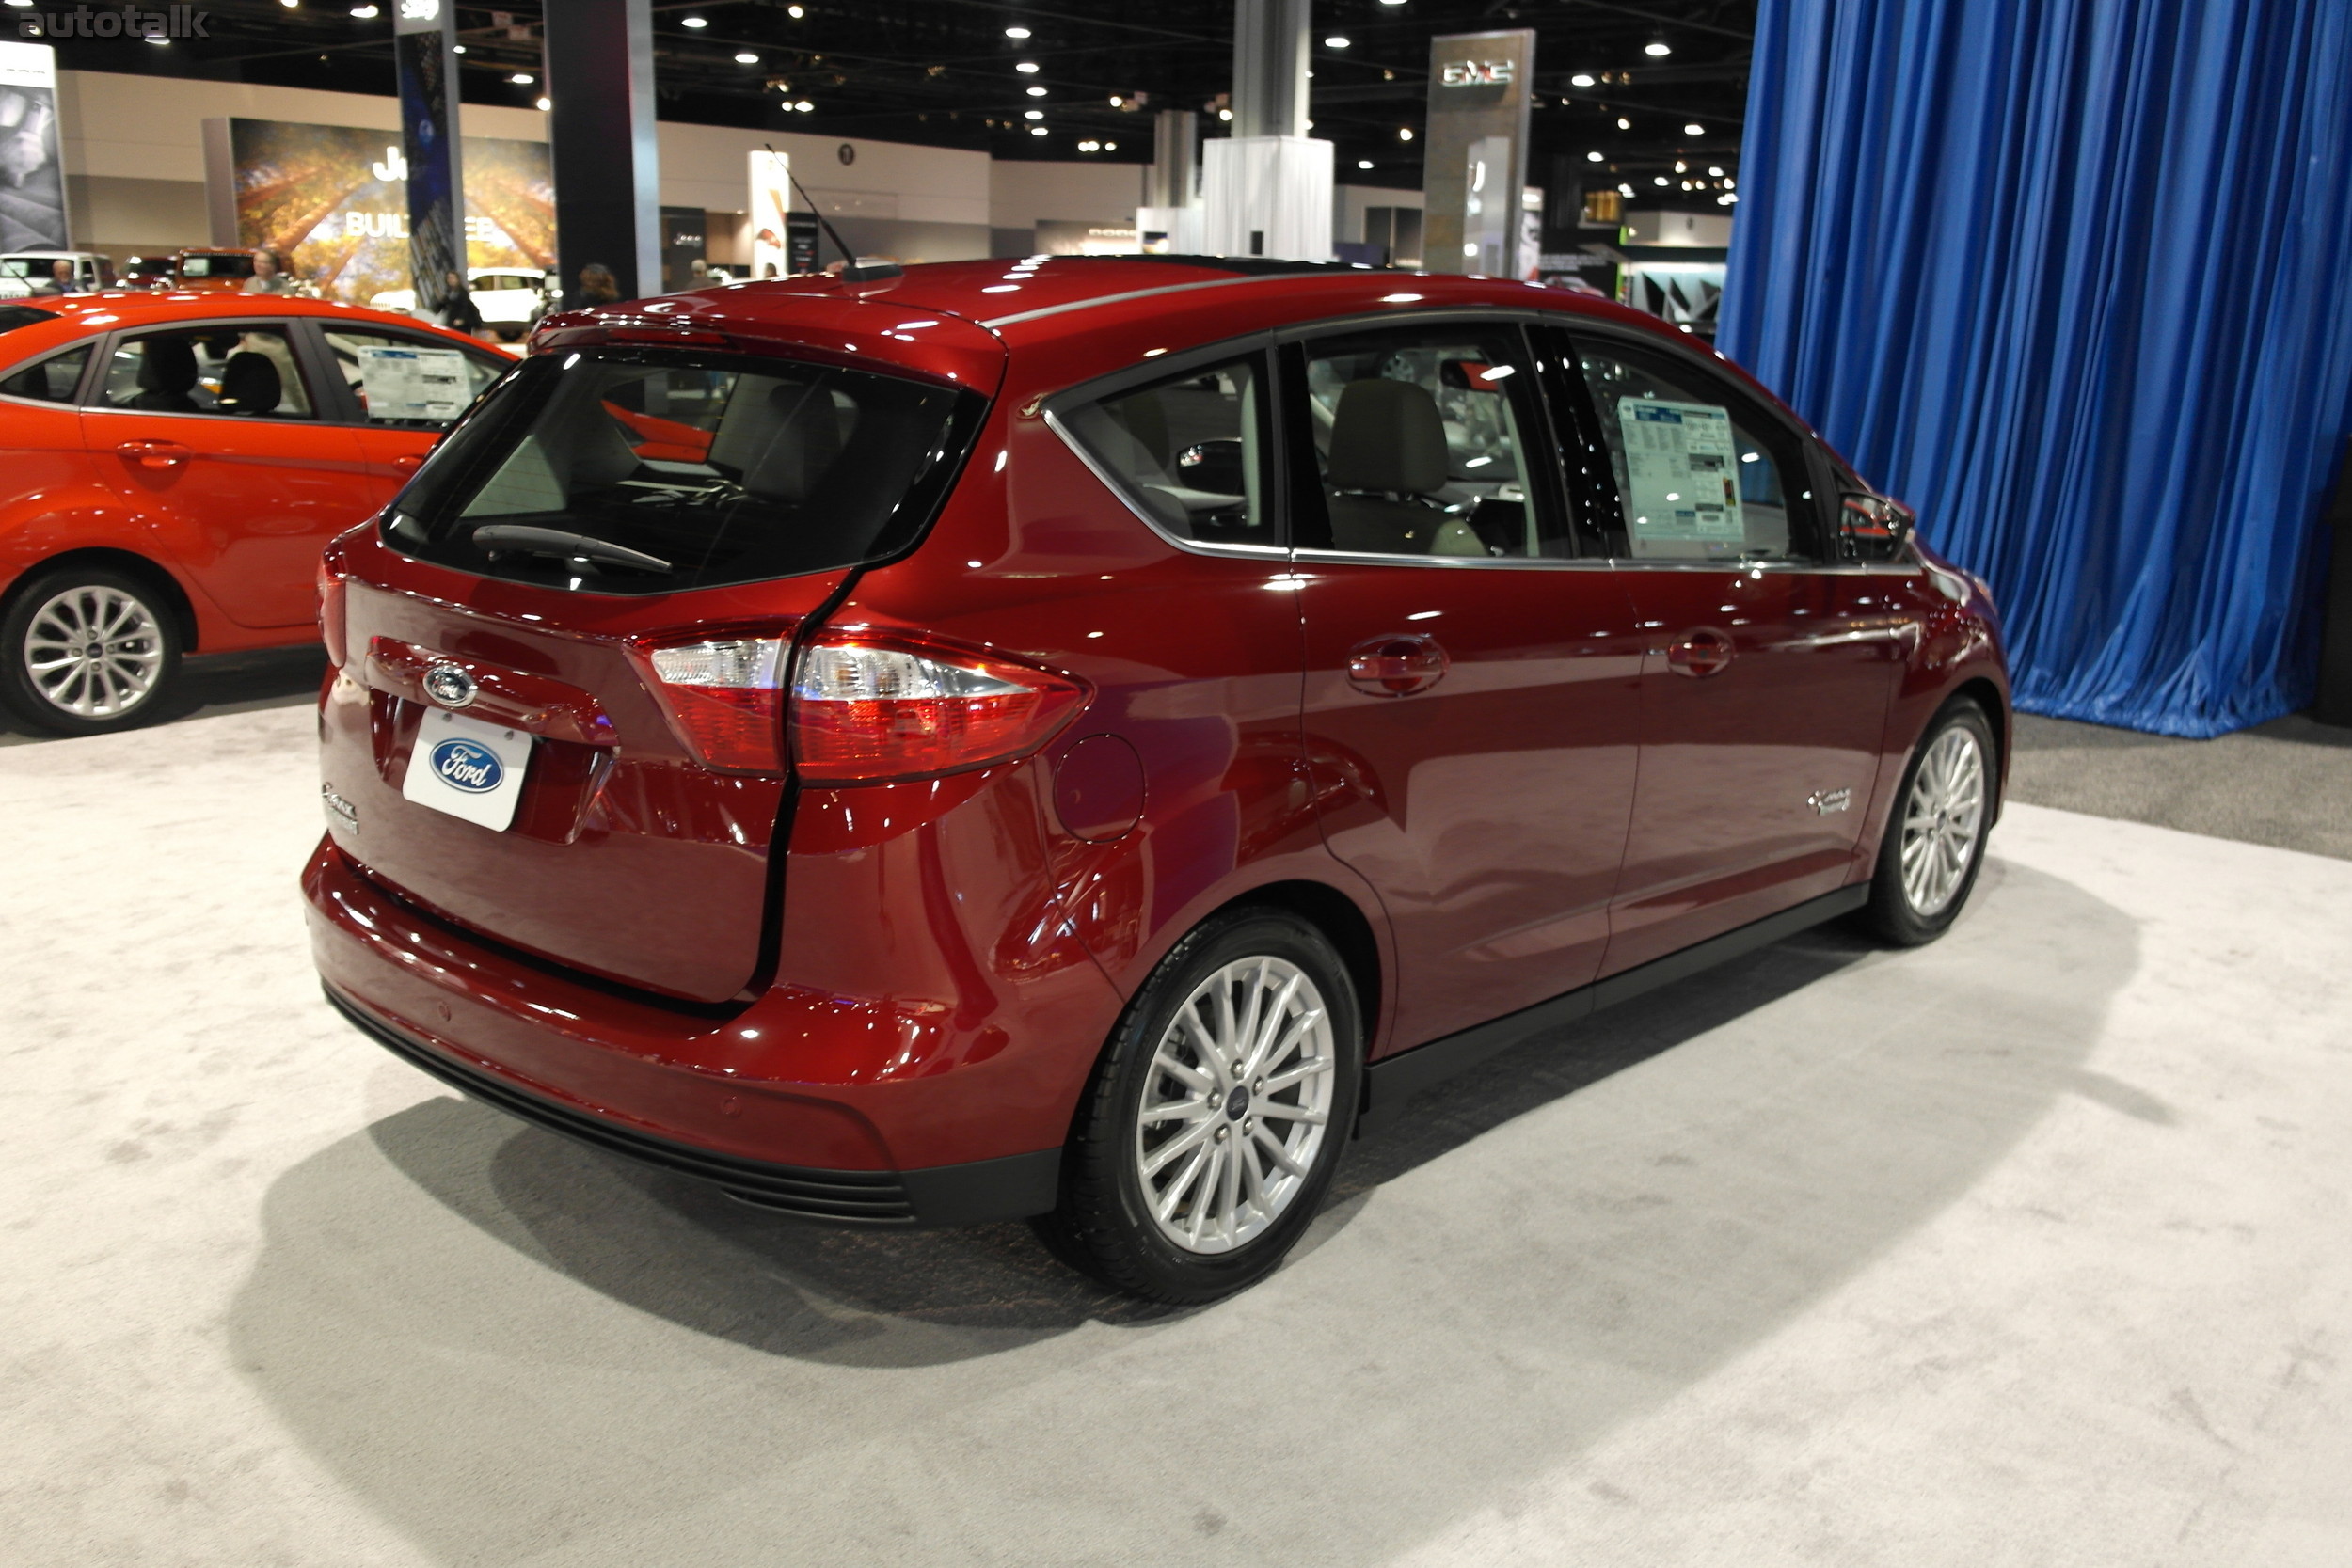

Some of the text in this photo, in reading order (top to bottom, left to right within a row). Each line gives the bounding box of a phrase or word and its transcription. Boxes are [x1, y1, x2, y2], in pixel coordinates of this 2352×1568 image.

[1438, 60, 1515, 87] GMC
[345, 211, 410, 239] BUIL
[441, 745, 492, 787] Ford
